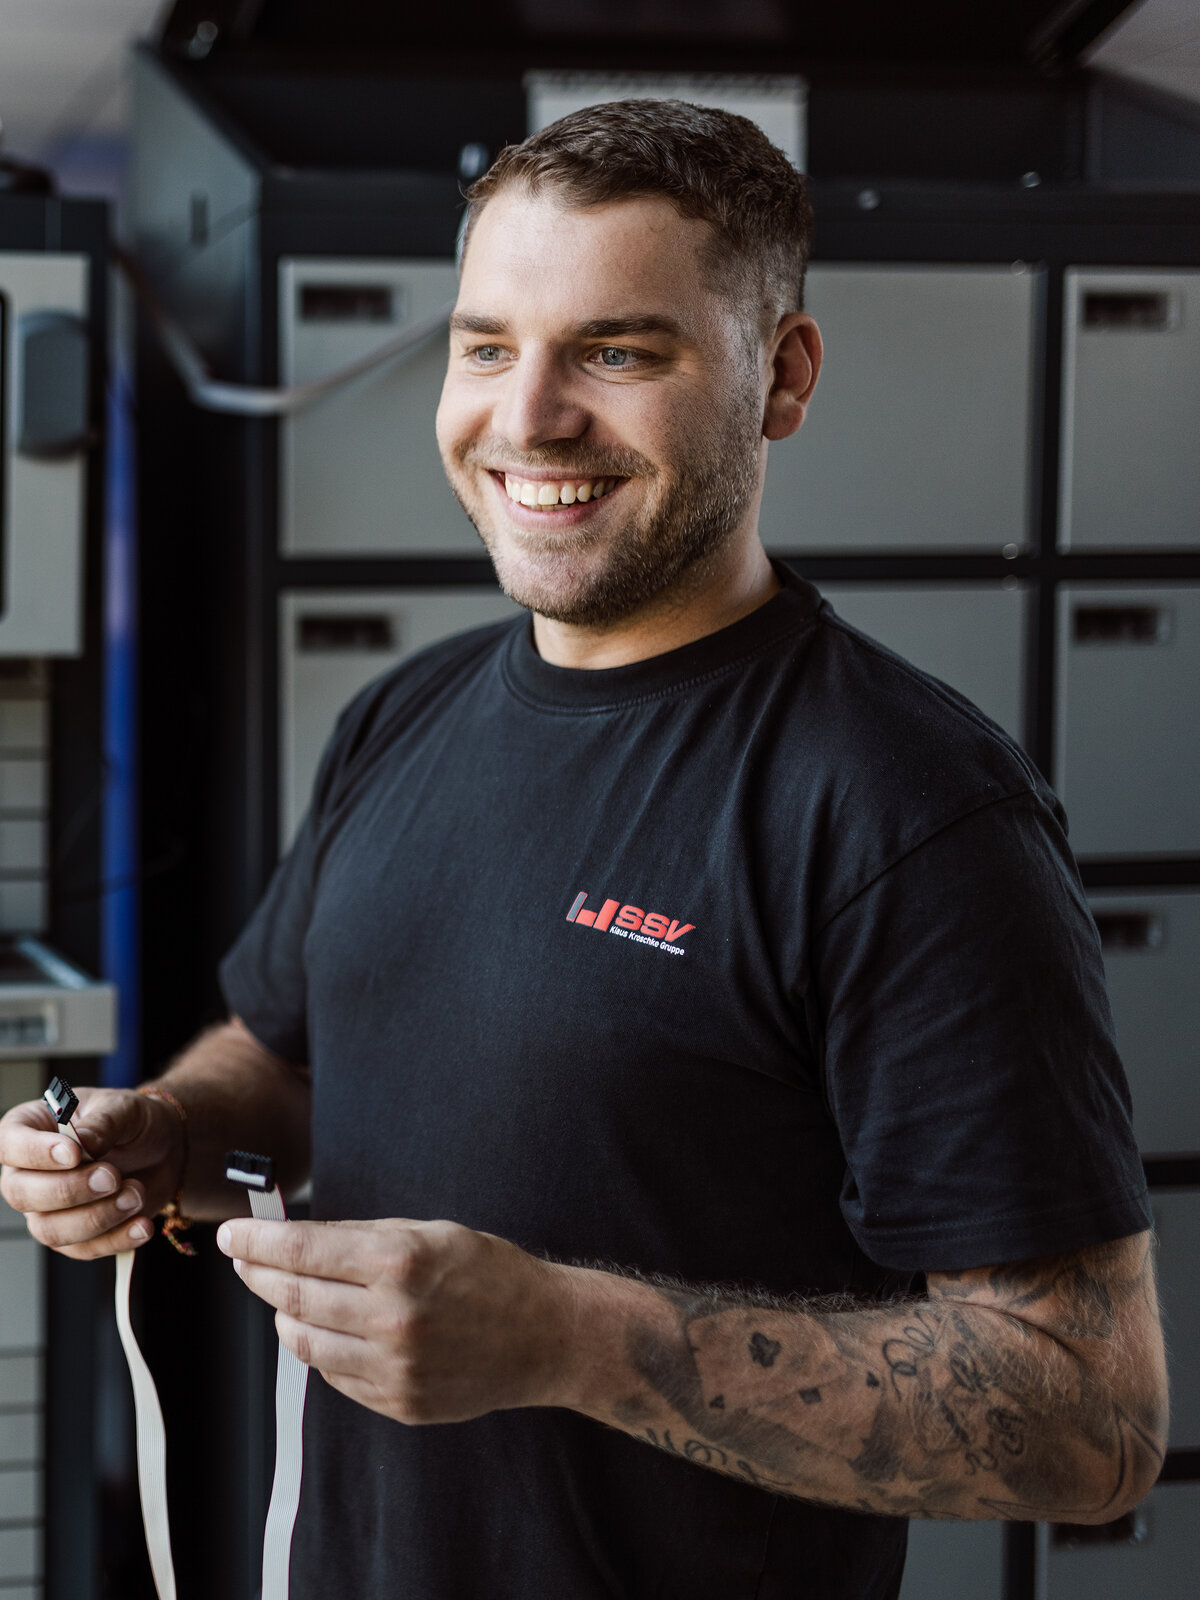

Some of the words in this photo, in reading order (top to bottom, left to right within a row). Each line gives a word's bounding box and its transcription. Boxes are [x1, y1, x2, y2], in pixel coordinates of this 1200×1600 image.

[615, 904, 696, 942] SSV
[609, 925, 628, 938] Klaus
[628, 931, 660, 948] Kroschke
[660, 941, 685, 956] Gruppe
